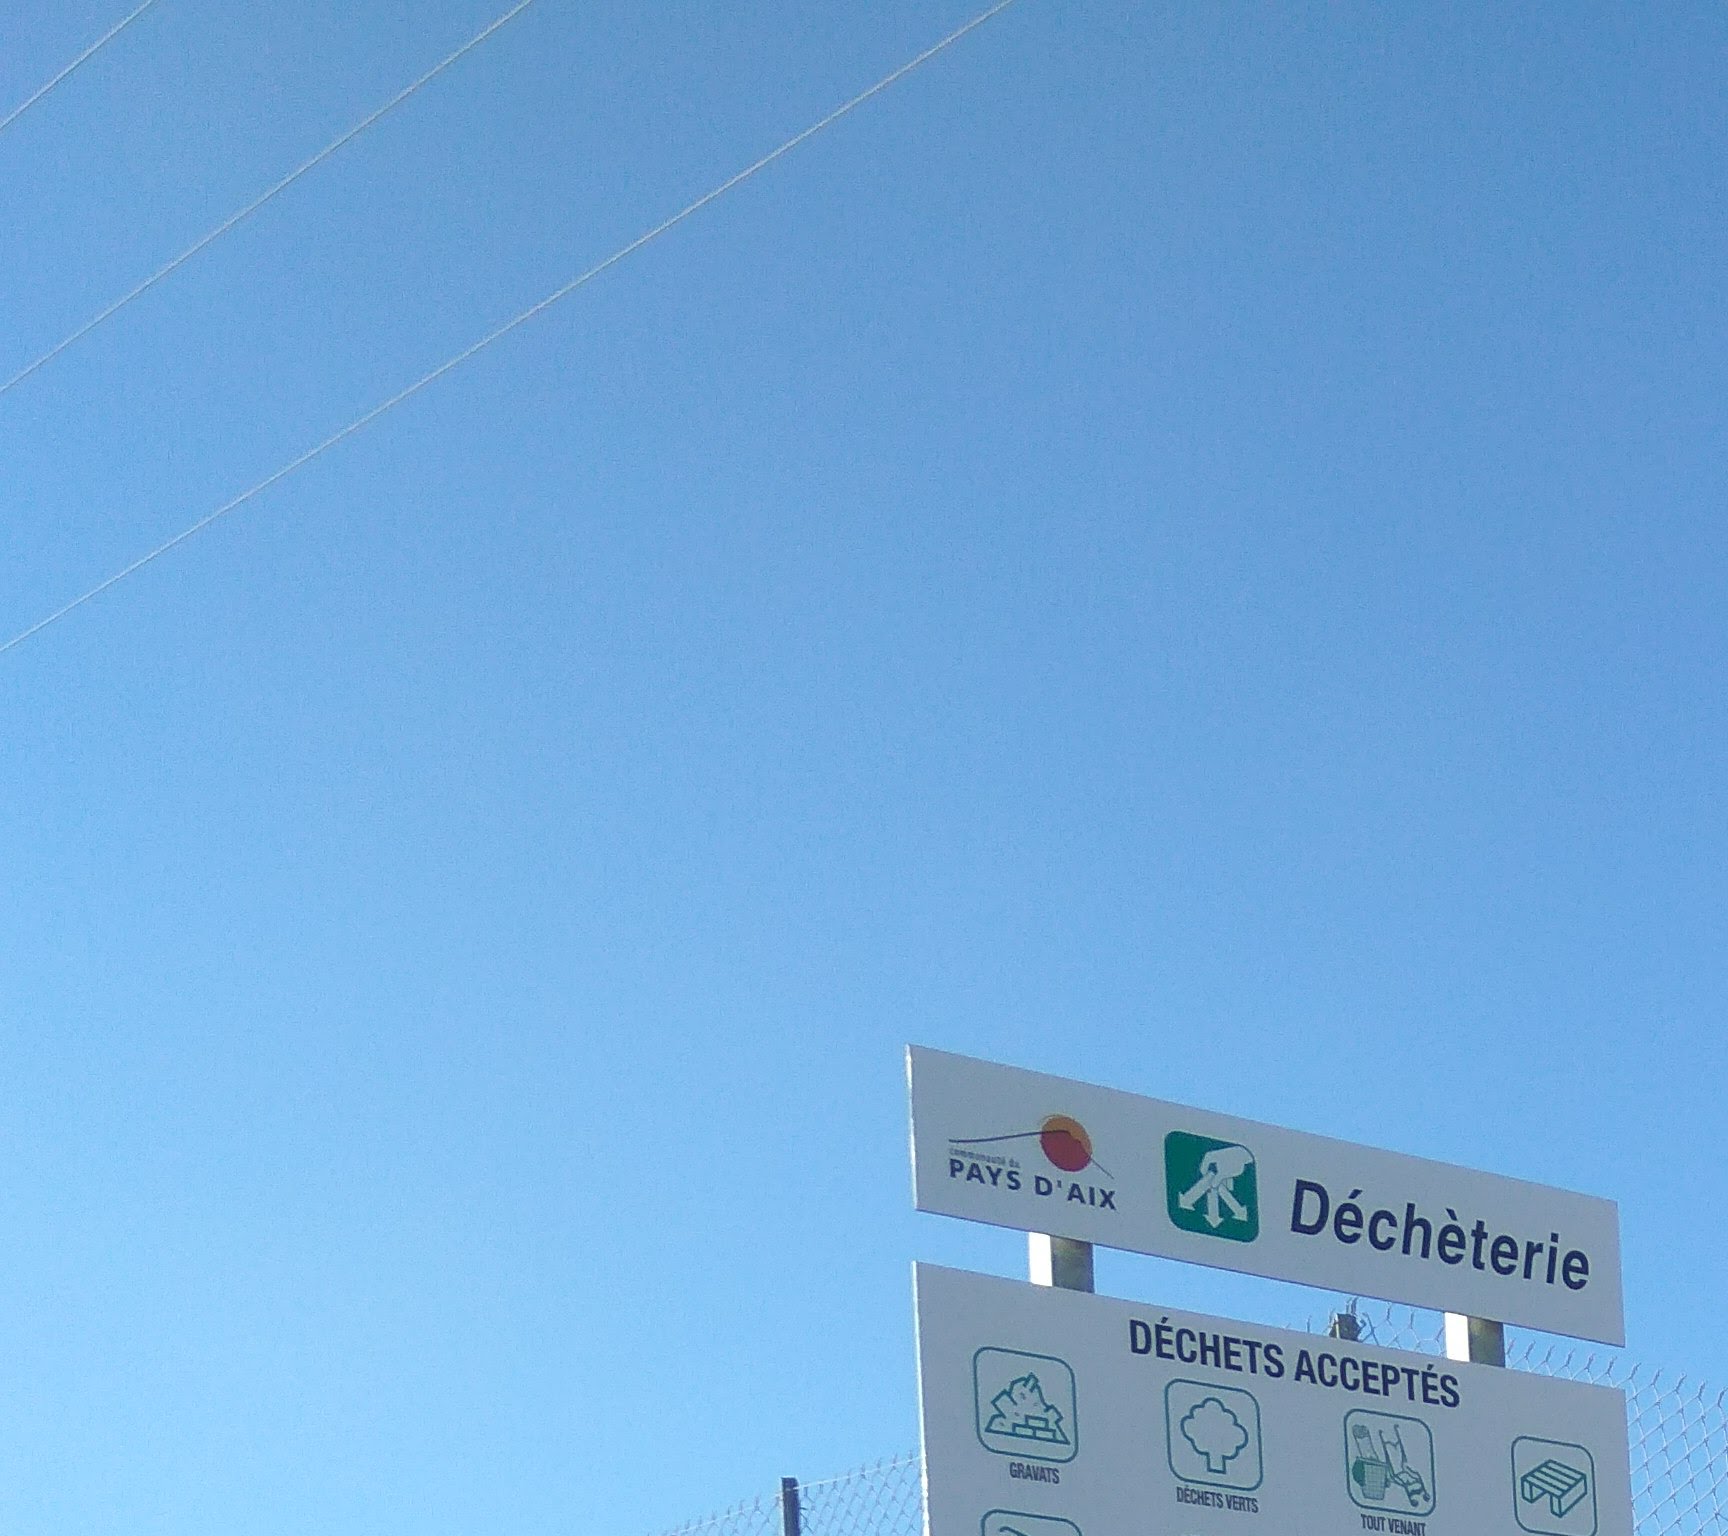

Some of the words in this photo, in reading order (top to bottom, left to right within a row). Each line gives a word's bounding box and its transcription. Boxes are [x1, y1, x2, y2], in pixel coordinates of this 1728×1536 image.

[949, 1157, 1022, 1191] PAYS
[1034, 1174, 1117, 1211] D'AIX
[1289, 1178, 1591, 1292] Déchèterie
[1129, 1317, 1285, 1379] DÉCHETS
[1294, 1346, 1460, 1408] ACCEPTÉS
[1009, 1461, 1060, 1485] GRAVATS
[1176, 1484, 1224, 1509] DÉCHETS
[1225, 1493, 1259, 1514] VERTS
[1360, 1513, 1386, 1532] TOUT
